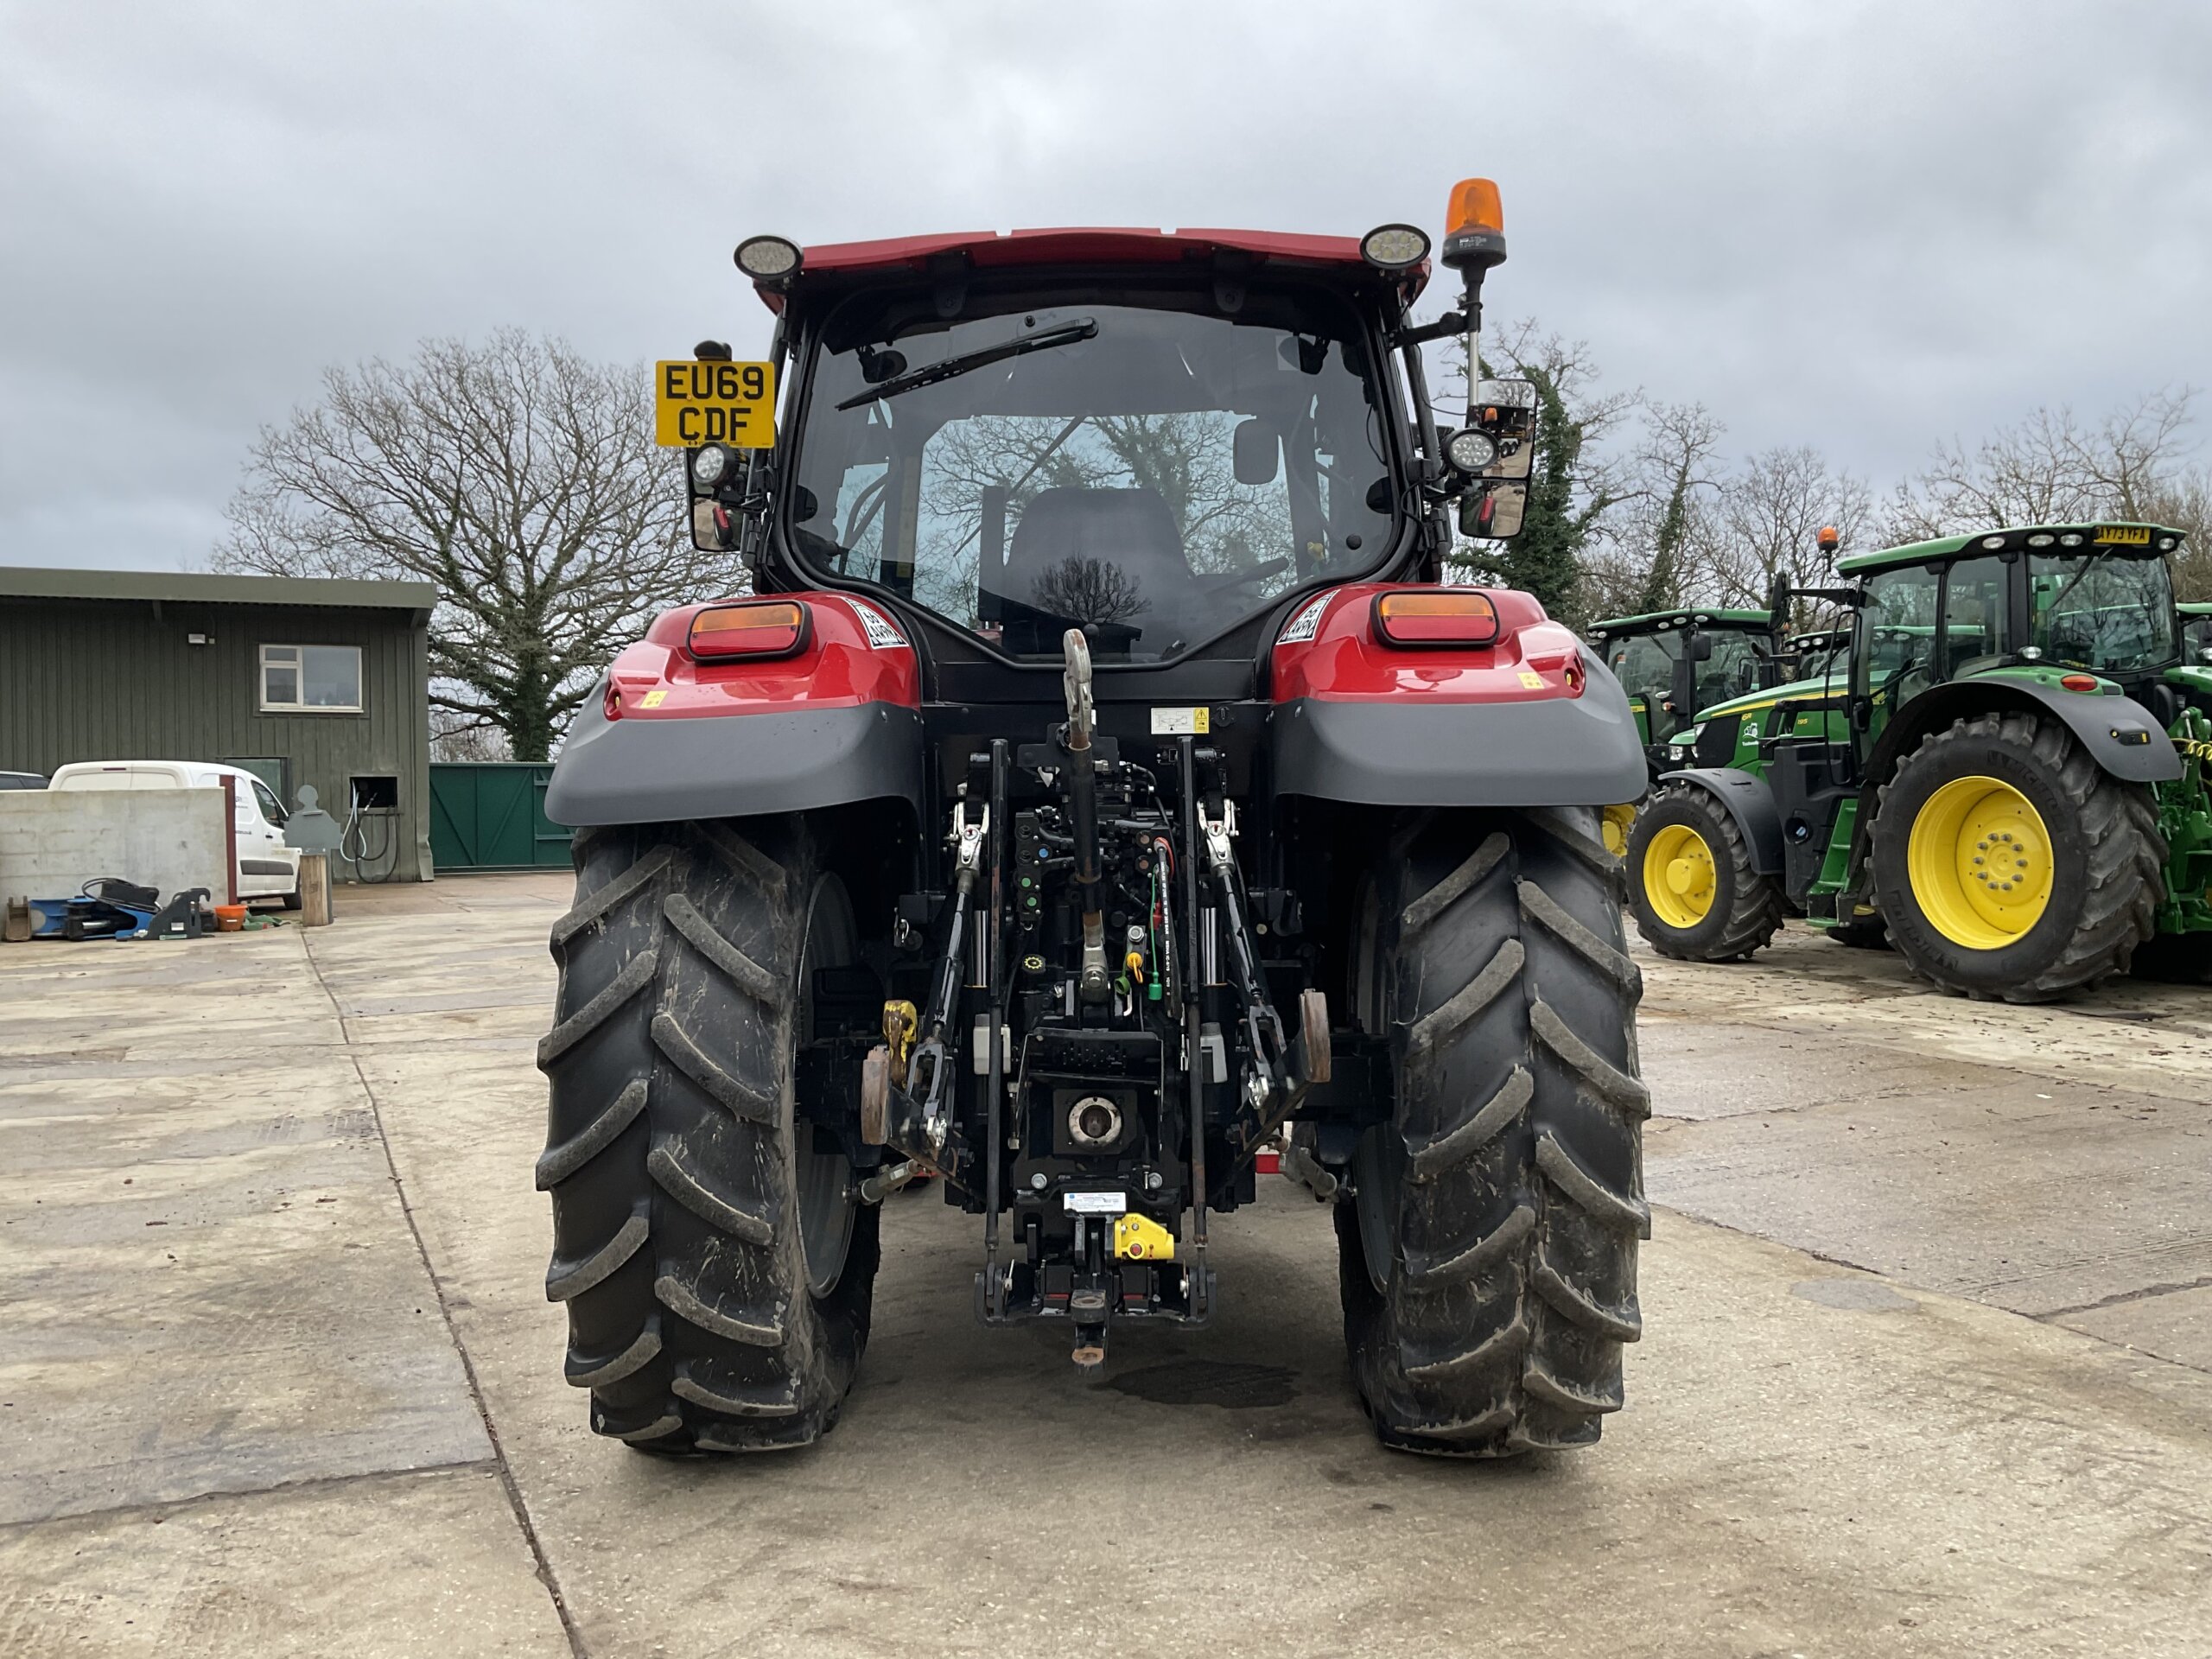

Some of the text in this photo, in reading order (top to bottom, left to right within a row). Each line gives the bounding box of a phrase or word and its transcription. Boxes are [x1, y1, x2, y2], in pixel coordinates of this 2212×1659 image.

[666, 365, 764, 400] EU69
[678, 407, 752, 442] CDF
[2126, 527, 2145, 540] YFA
